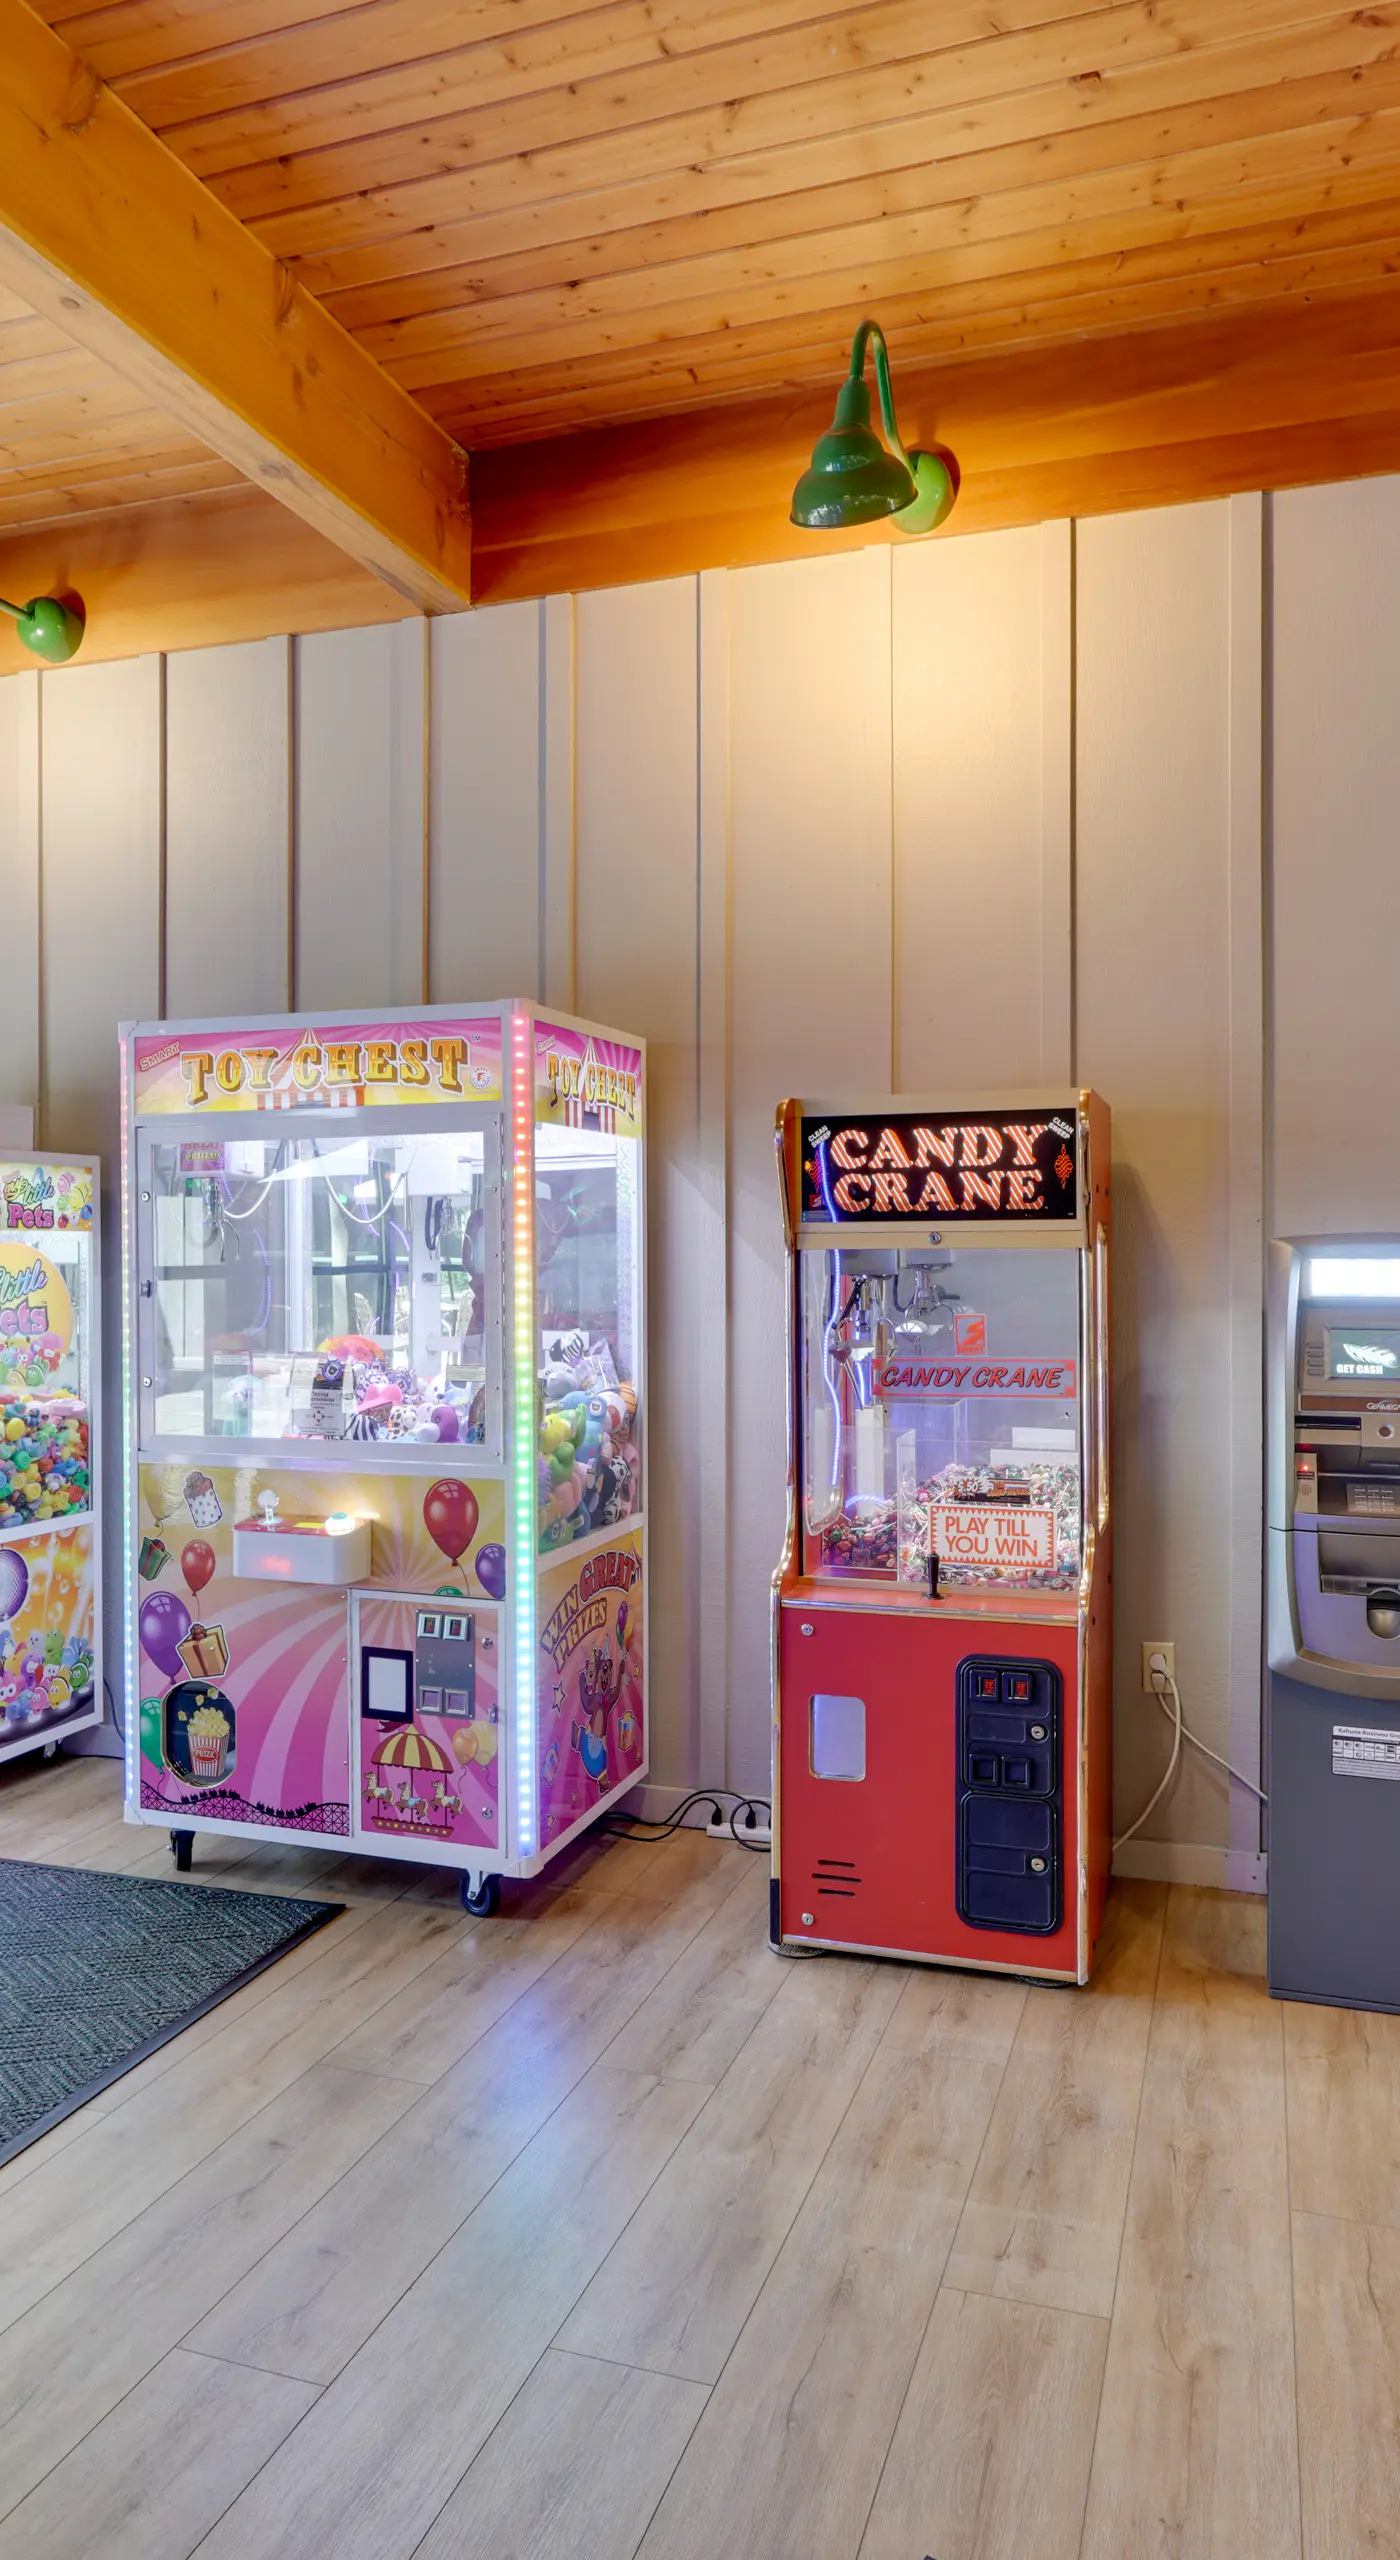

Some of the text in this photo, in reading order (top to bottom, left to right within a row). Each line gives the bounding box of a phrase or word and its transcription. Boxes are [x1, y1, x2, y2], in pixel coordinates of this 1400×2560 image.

[140, 1041, 180, 1071] SMART
[180, 1037, 469, 1107] TOY CHEST
[546, 1051, 638, 1121] TOY CHEST
[808, 1125, 828, 1142] CLEAN
[1048, 1122, 1071, 1139] SWEEP
[1052, 1117, 1074, 1134] CLEAN
[811, 1130, 831, 1148] SWEEP
[831, 1125, 1048, 1169] CANDY
[23, 1176, 55, 1206] little
[834, 1169, 1044, 1212] CRANE
[7, 1202, 54, 1228] Pets
[0, 1297, 49, 1335] ets
[880, 1366, 1064, 1388] CANDY CRANE
[1336, 1364, 1383, 1375] GET CASH
[945, 1515, 1030, 1537] PLAY TILL
[945, 1535, 1038, 1557] YOU WIN
[540, 1550, 637, 1654] WIN GREAT
[553, 1597, 608, 1674] PRIZES
[1338, 1727, 1361, 1735] Kahuna
[1362, 1730, 1388, 1738] Business
[195, 1749, 216, 1758] PRIZE
